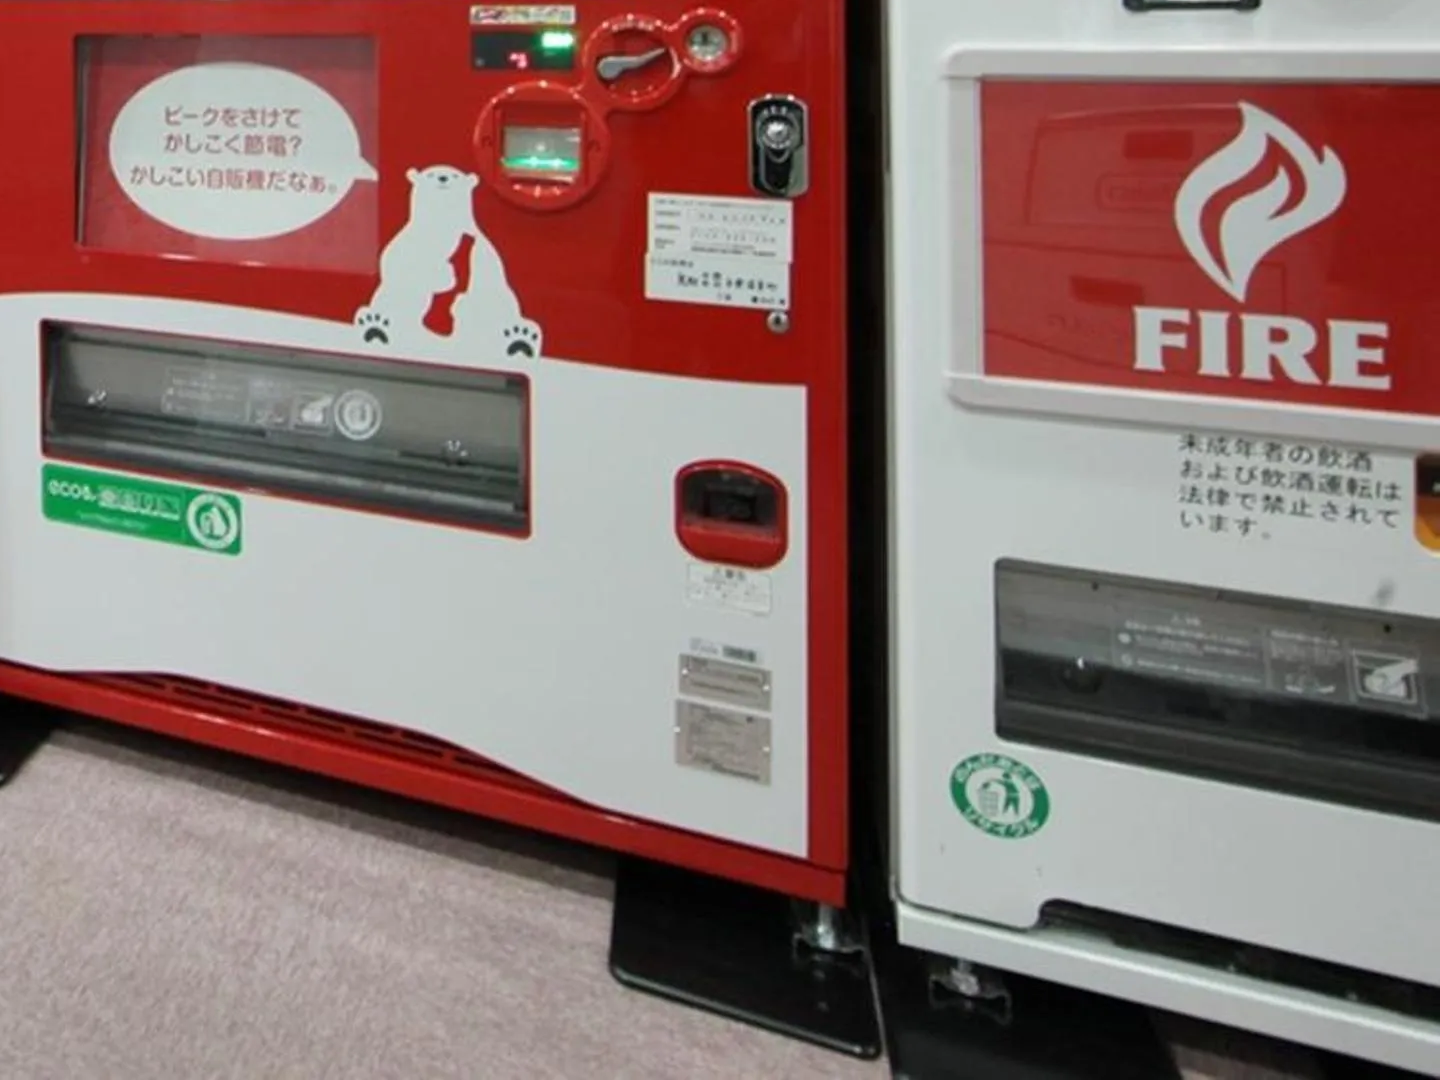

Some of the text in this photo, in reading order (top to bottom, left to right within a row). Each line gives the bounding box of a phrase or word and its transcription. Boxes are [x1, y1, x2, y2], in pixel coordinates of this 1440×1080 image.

[164, 106, 302, 130] ピークをさけて
[1132, 304, 1392, 391] FIRE
[1178, 433, 1373, 472] 未成年者の飲酒
[1179, 459, 1402, 501] および飲酒運転は
[1177, 485, 1401, 529] 法律で禁止されて
